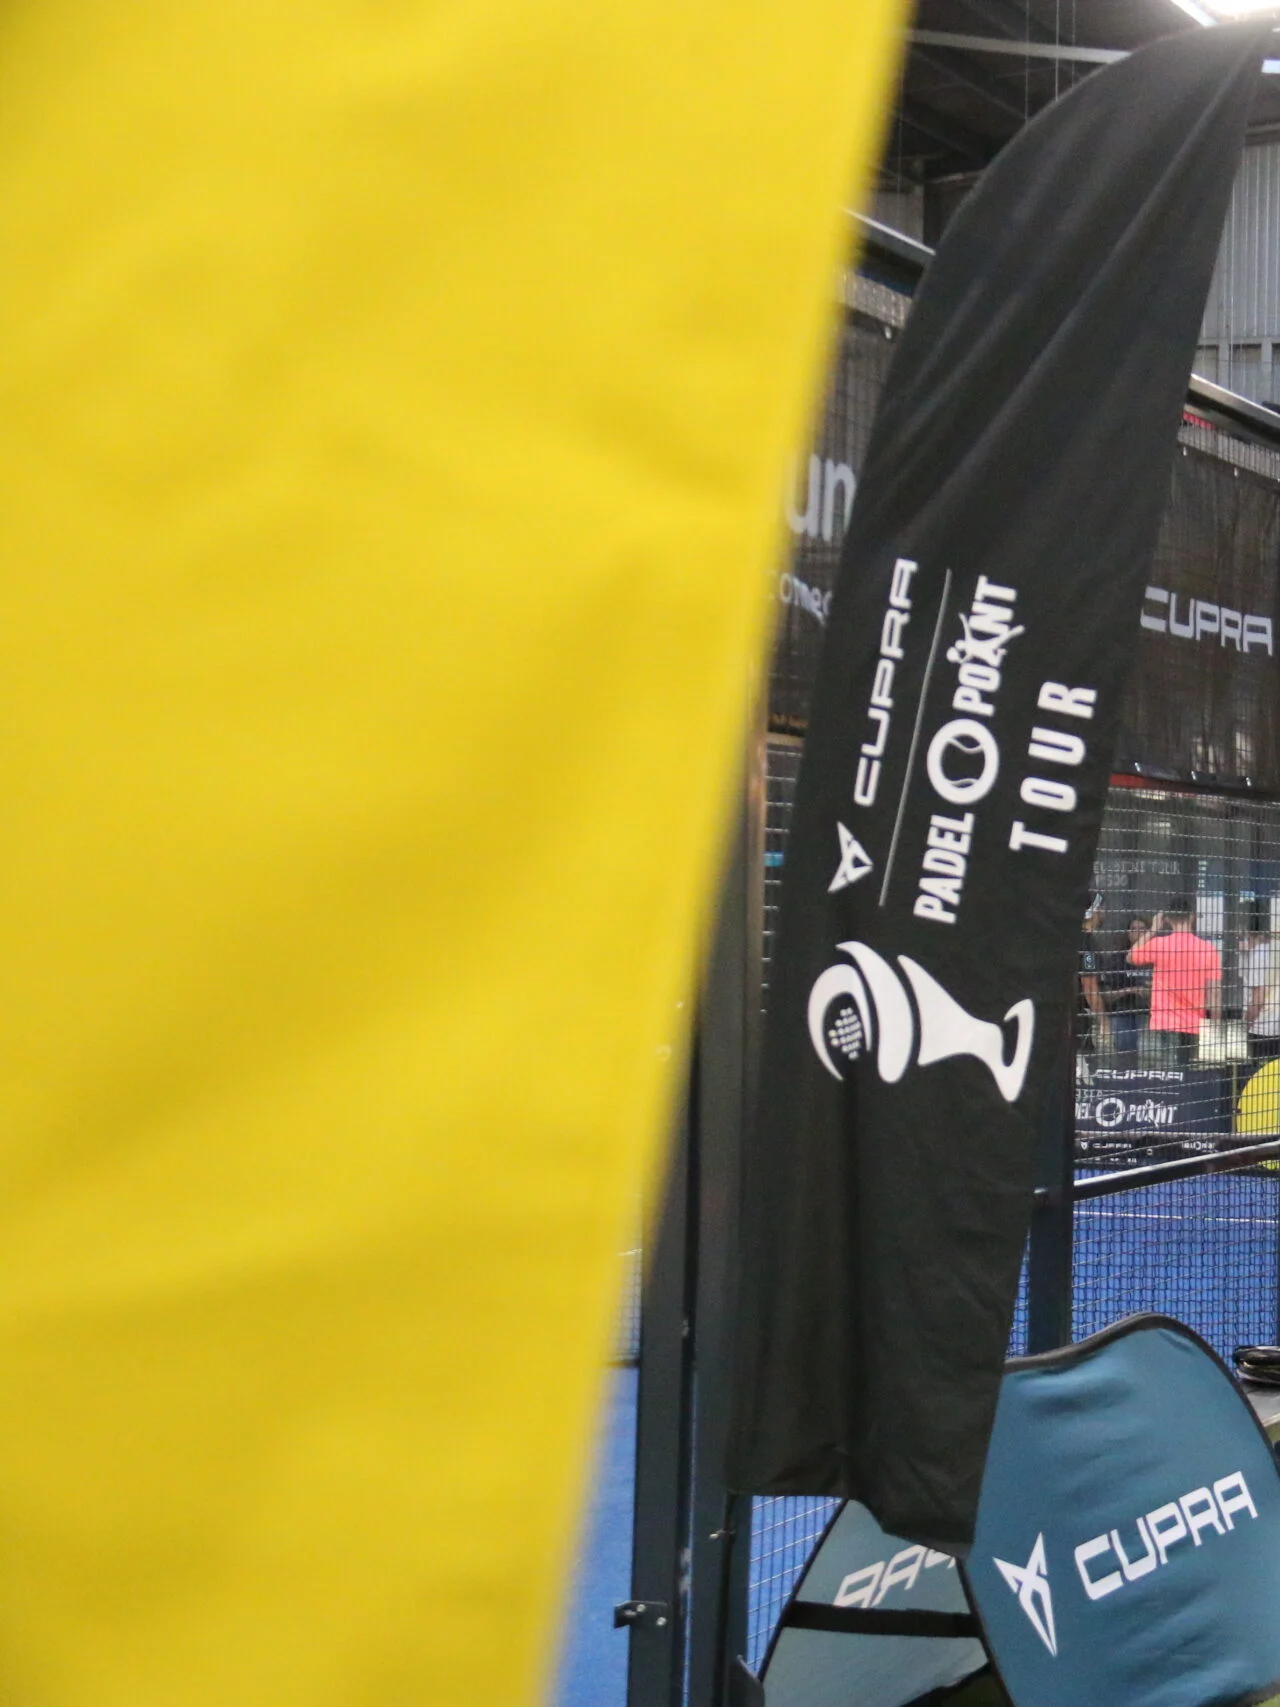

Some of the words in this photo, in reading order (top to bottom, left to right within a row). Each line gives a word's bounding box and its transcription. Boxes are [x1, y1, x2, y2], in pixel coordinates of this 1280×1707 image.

[1140, 586, 1272, 656] CUPRA
[854, 558, 918, 807] CUPRA
[1009, 681, 1098, 853] TOUR
[913, 812, 975, 924] PADEL
[1093, 1069, 1184, 1081] CUPRA
[1074, 1471, 1258, 1600] CUPRA
